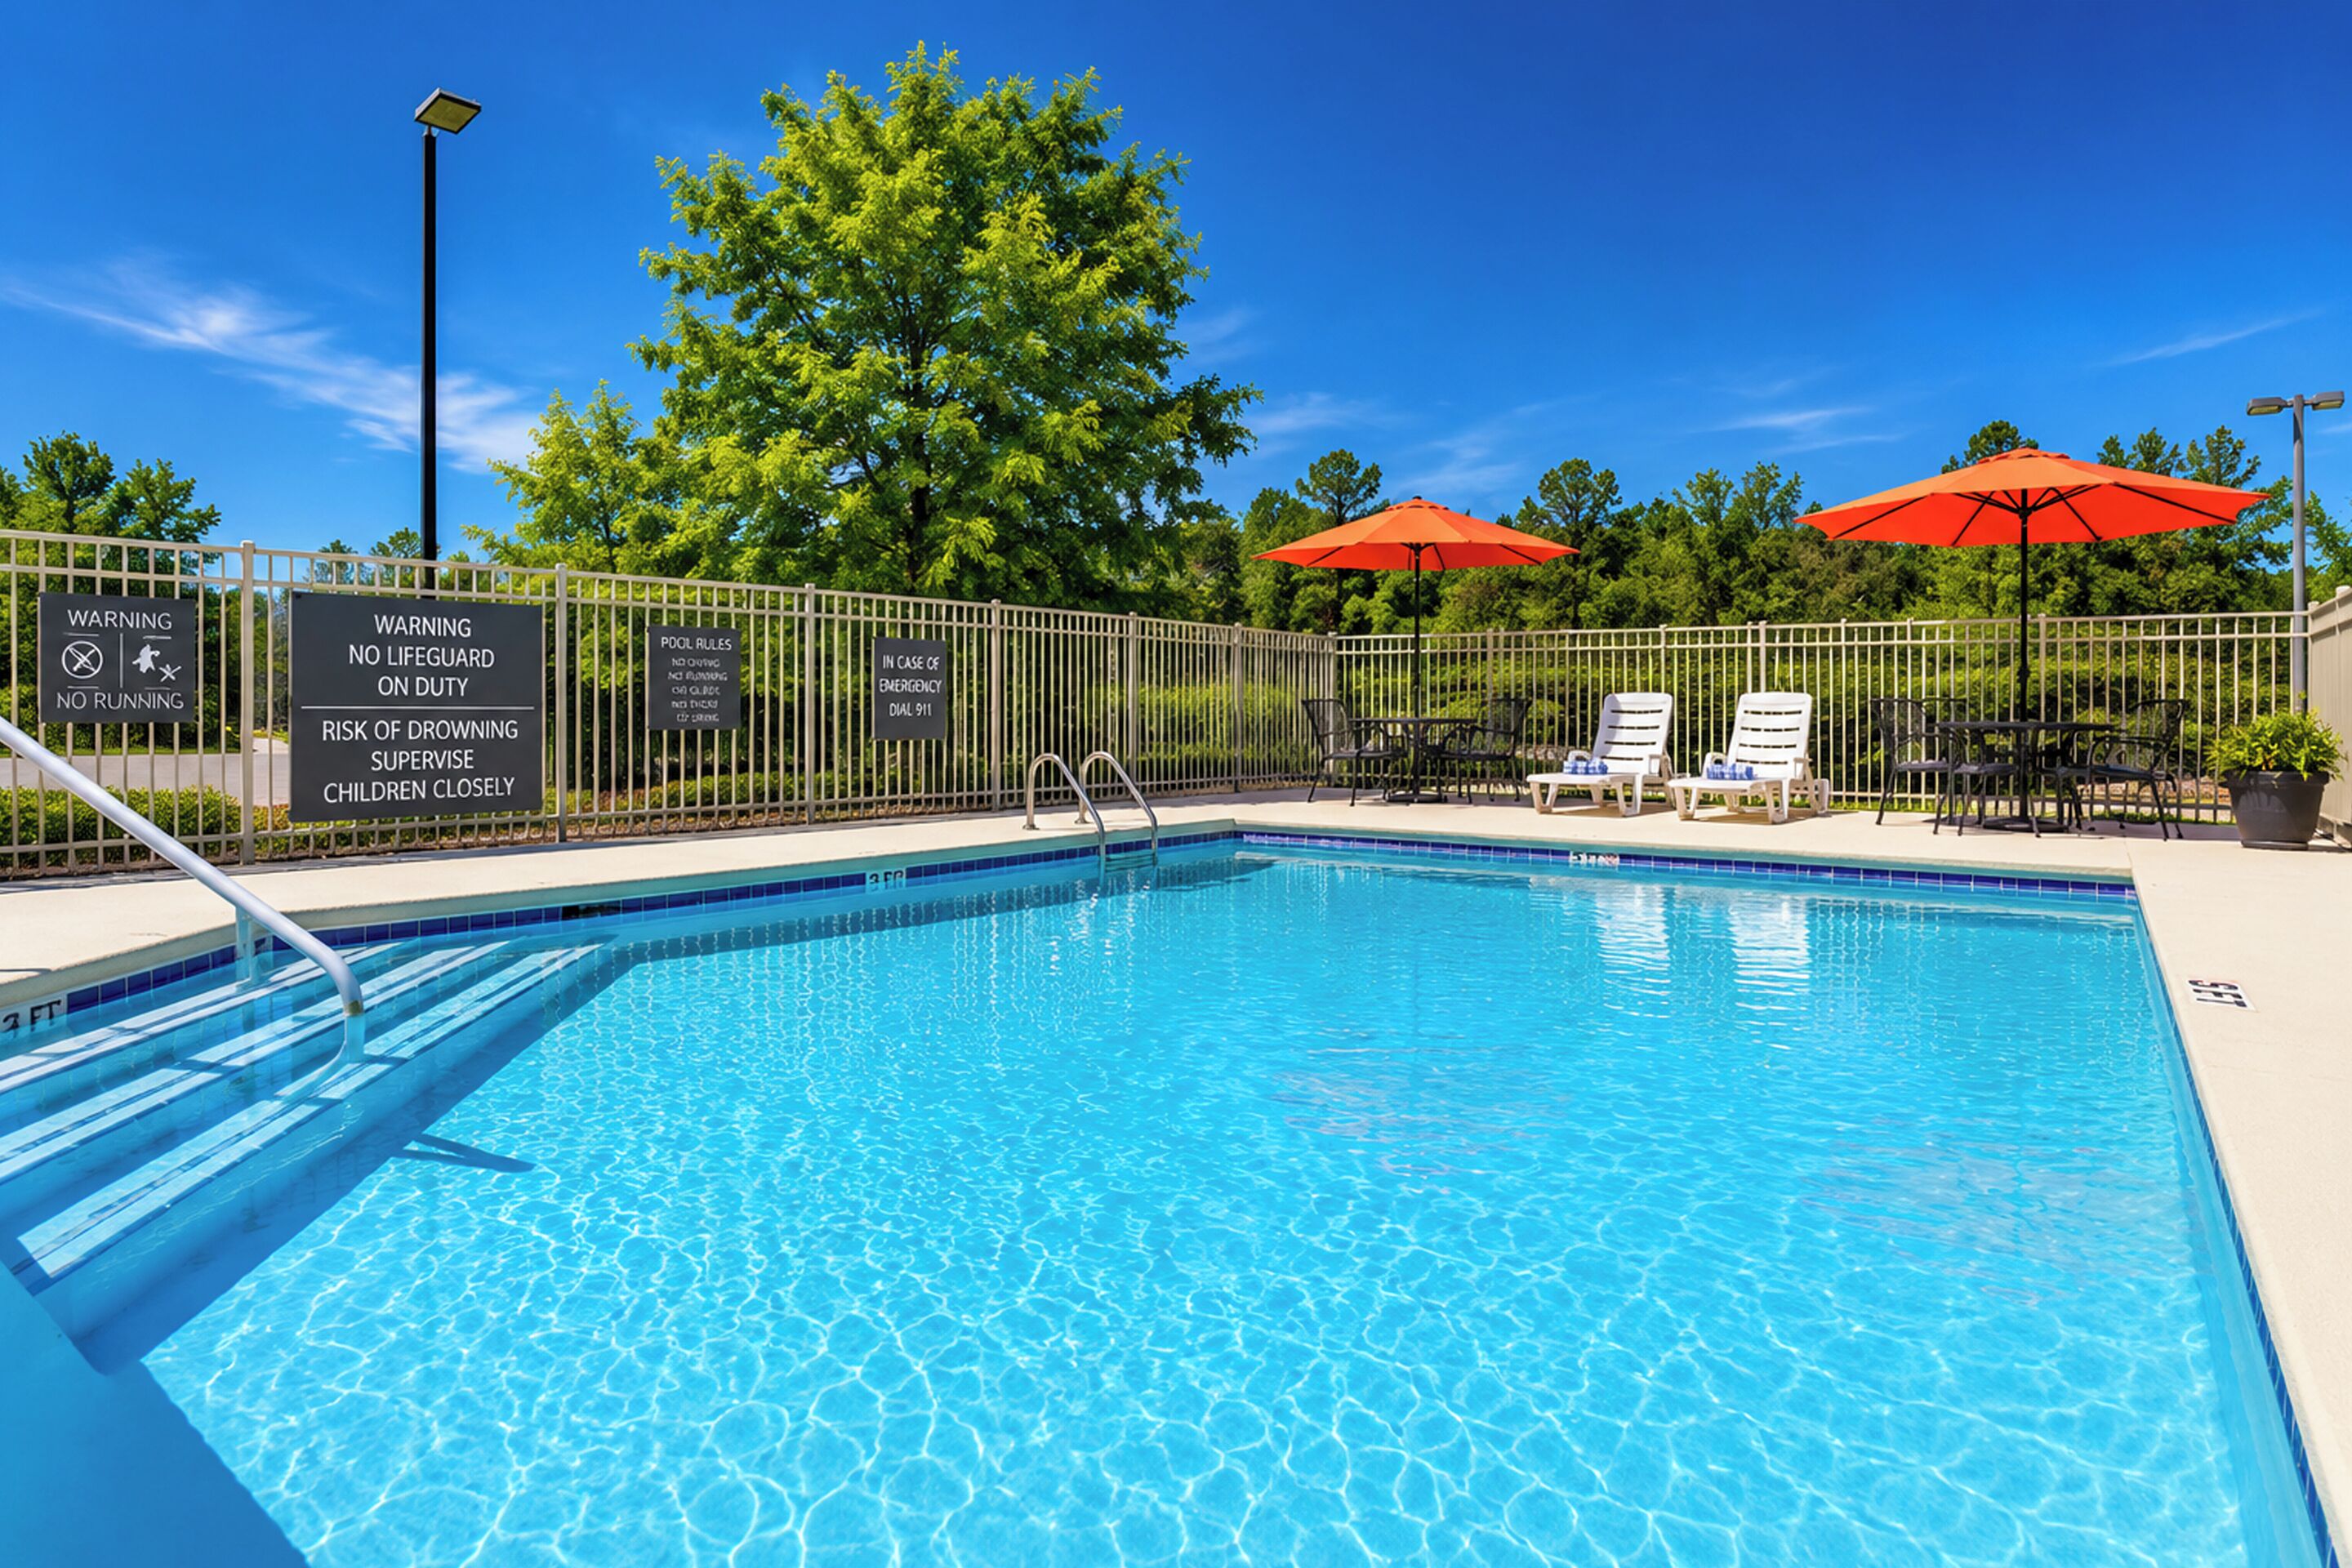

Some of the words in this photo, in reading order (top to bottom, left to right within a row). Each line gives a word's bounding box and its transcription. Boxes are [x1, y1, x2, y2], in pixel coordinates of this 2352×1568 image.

[67, 608, 172, 630] WARNING
[373, 614, 472, 638] WARNING
[661, 636, 693, 650] POOL
[696, 637, 733, 651] RULES
[349, 644, 381, 666] NO
[387, 646, 496, 668] LIFEGUARD
[883, 654, 894, 669] IN
[897, 655, 924, 670] CASE
[377, 676, 408, 697] ON
[415, 677, 469, 697] DUTY
[56, 691, 87, 710] NO
[95, 692, 184, 710] RUNNING
[889, 702, 913, 717] DIAL
[915, 702, 932, 717] 911
[323, 720, 368, 741] RISK
[374, 720, 401, 741] OF
[408, 719, 519, 740] DROWNING
[371, 749, 474, 771] SUPERVISE
[323, 780, 426, 804] CHILDREN
[433, 777, 515, 799] CLOSELY
